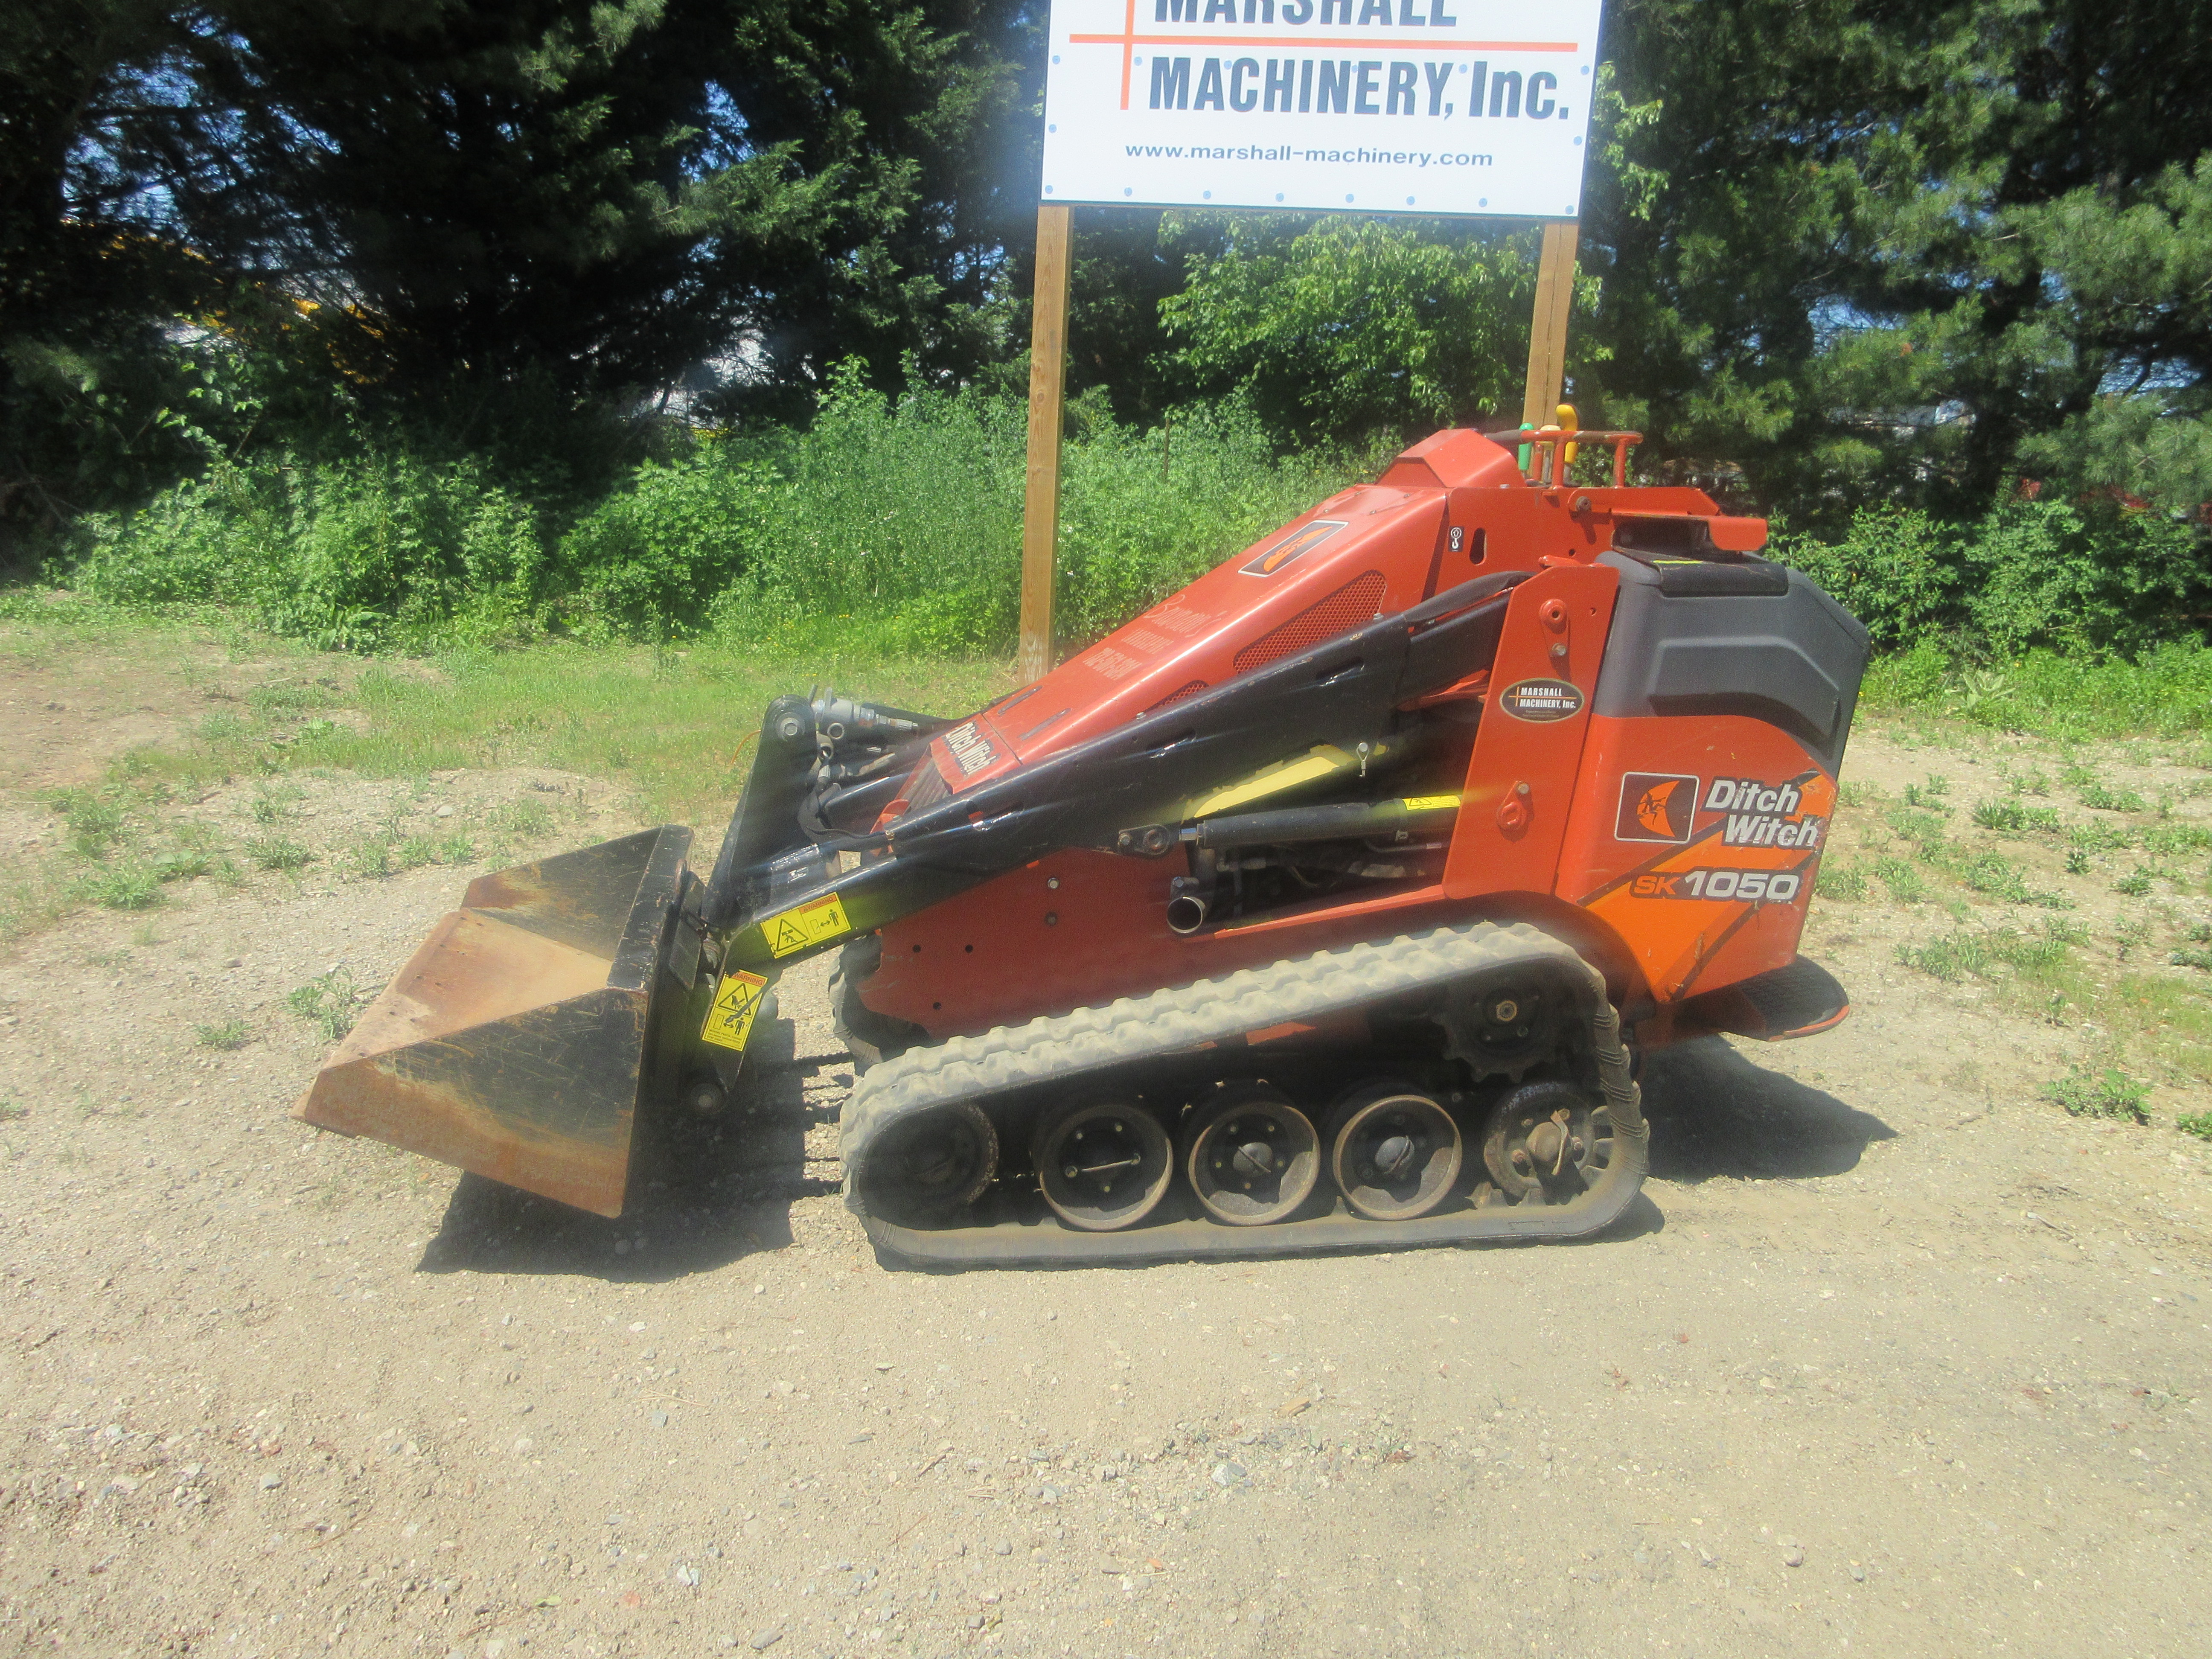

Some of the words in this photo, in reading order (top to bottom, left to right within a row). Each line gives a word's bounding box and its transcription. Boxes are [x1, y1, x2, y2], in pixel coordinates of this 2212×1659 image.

[1149, 57, 1453, 121] MACHINERY,
[1469, 61, 1569, 120] Inc.
[1125, 145, 1493, 166] www.marshall-machinery.com
[1519, 699, 1560, 708] MACHINERY,
[1563, 700, 1576, 708] Inc.
[1521, 687, 1562, 696] MARSHALL
[945, 722, 981, 754] Ditch
[958, 740, 996, 775] Witch
[1706, 780, 1799, 812] Ditch
[1723, 814, 1819, 847] Witch
[1634, 875, 1681, 895] SK
[1685, 870, 1799, 900] 1050
[808, 897, 833, 909] WARNING
[734, 973, 763, 985] WARNING
